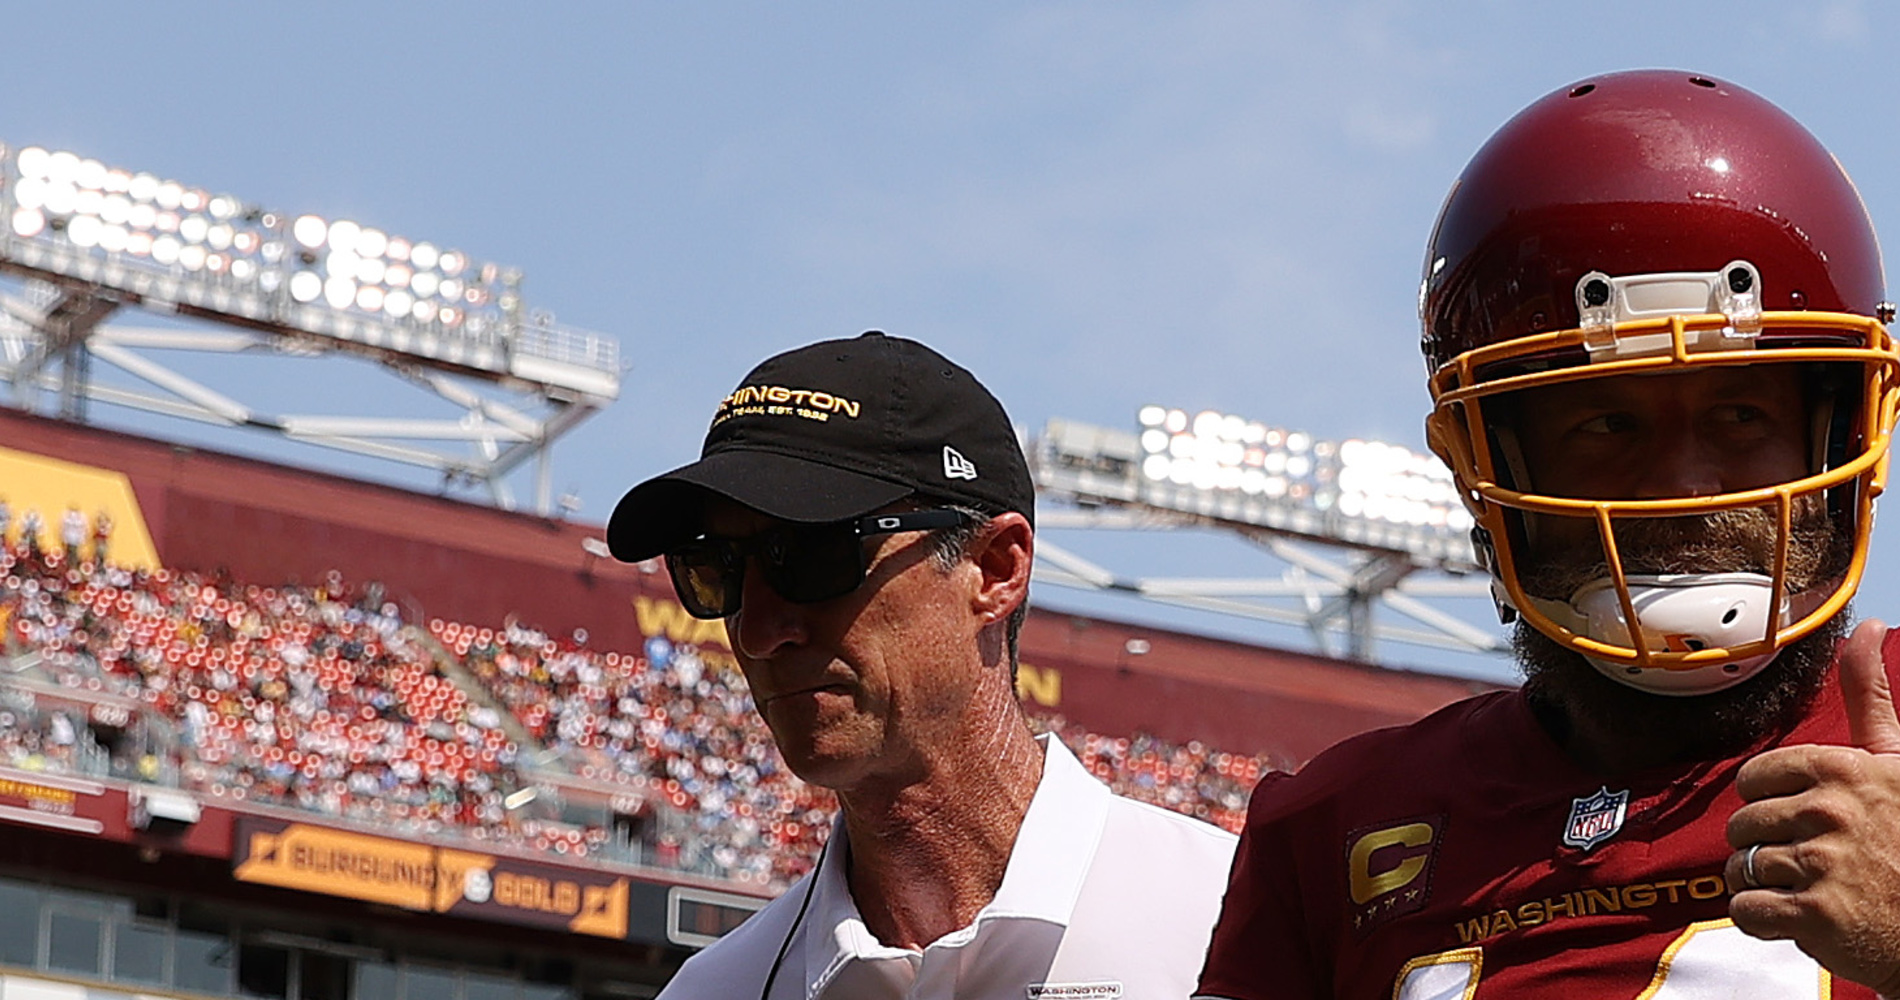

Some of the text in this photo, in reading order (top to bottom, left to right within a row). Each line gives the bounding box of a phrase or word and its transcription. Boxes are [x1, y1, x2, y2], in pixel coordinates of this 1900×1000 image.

[1348, 822, 1434, 906] C
[494, 871, 582, 917] GOLD
[1455, 875, 1726, 944] WASHINGTO
[1029, 985, 1117, 997] WASHINGTON
